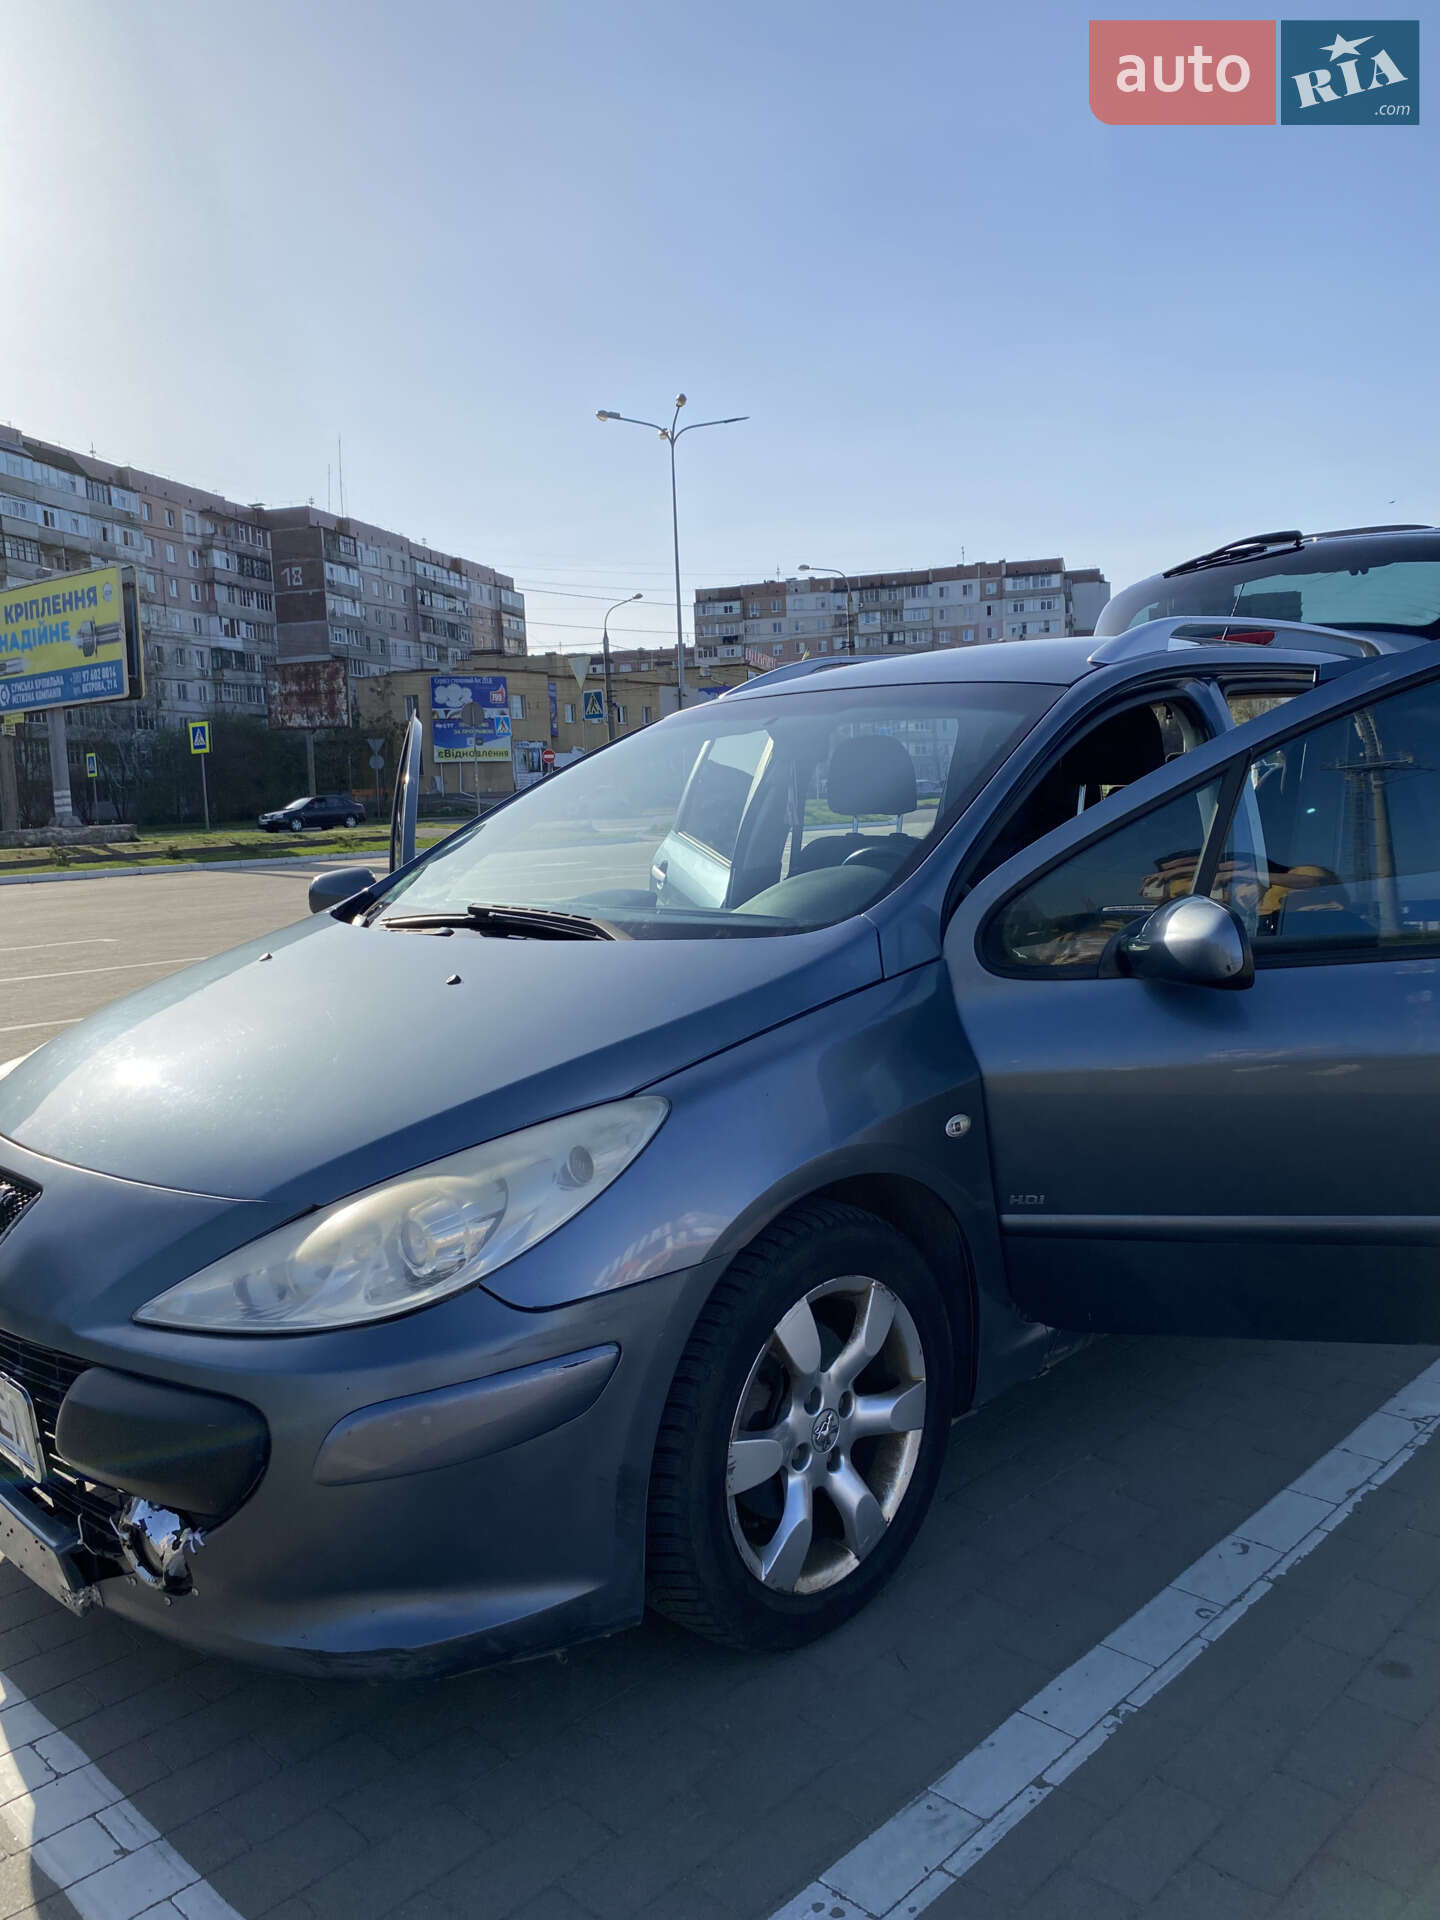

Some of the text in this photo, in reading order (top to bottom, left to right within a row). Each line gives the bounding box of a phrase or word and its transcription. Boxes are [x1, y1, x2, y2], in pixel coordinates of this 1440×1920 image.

[281, 566, 303, 587] 18
[4, 585, 98, 625] КРІПЛЕННЯ
[0, 620, 71, 654] НАДІЙНЕ
